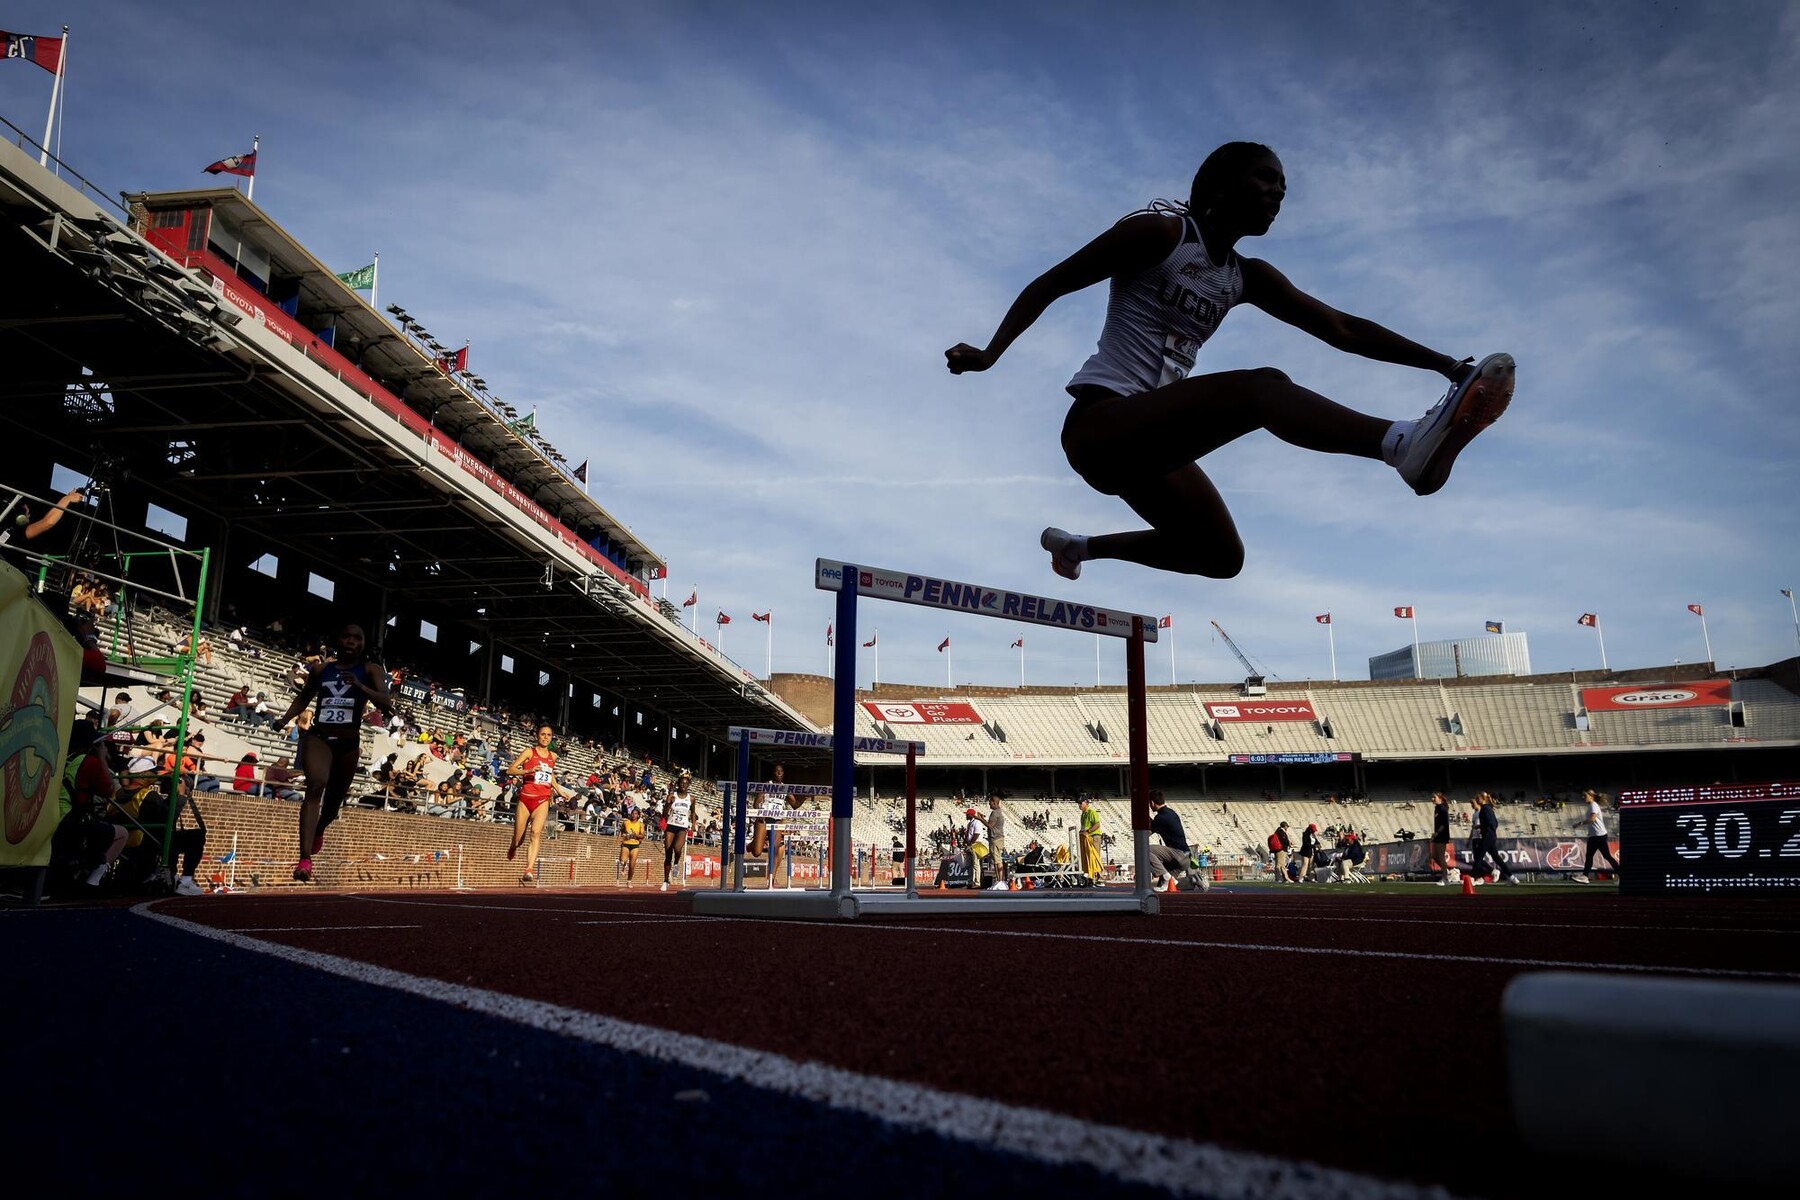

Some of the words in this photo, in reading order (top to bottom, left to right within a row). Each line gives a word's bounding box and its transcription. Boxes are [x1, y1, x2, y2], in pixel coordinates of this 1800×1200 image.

[226, 288, 254, 314] TOYOTA
[1158, 278, 1223, 323] UCON
[267, 319, 291, 340] TOYOTA
[454, 446, 494, 481] UNIVERSITY
[496, 479, 506, 490] OF
[508, 488, 549, 524] PENNSYLVANIA
[874, 577, 904, 589] TOYOTA
[904, 575, 982, 609] PENN
[1003, 592, 1095, 628] RELAYS
[1108, 617, 1130, 627] TOYOTA
[1623, 693, 1685, 703] Grace
[326, 710, 345, 722] 28
[1243, 706, 1310, 715] TOYOTA
[773, 731, 817, 746] PENN
[538, 773, 549, 782] 23
[748, 783, 779, 793] PENN
[787, 785, 828, 795] RELAYS
[757, 809, 780, 817] PENN
[786, 810, 817, 818] RELAYS
[1388, 853, 1406, 865] TOYOTA
